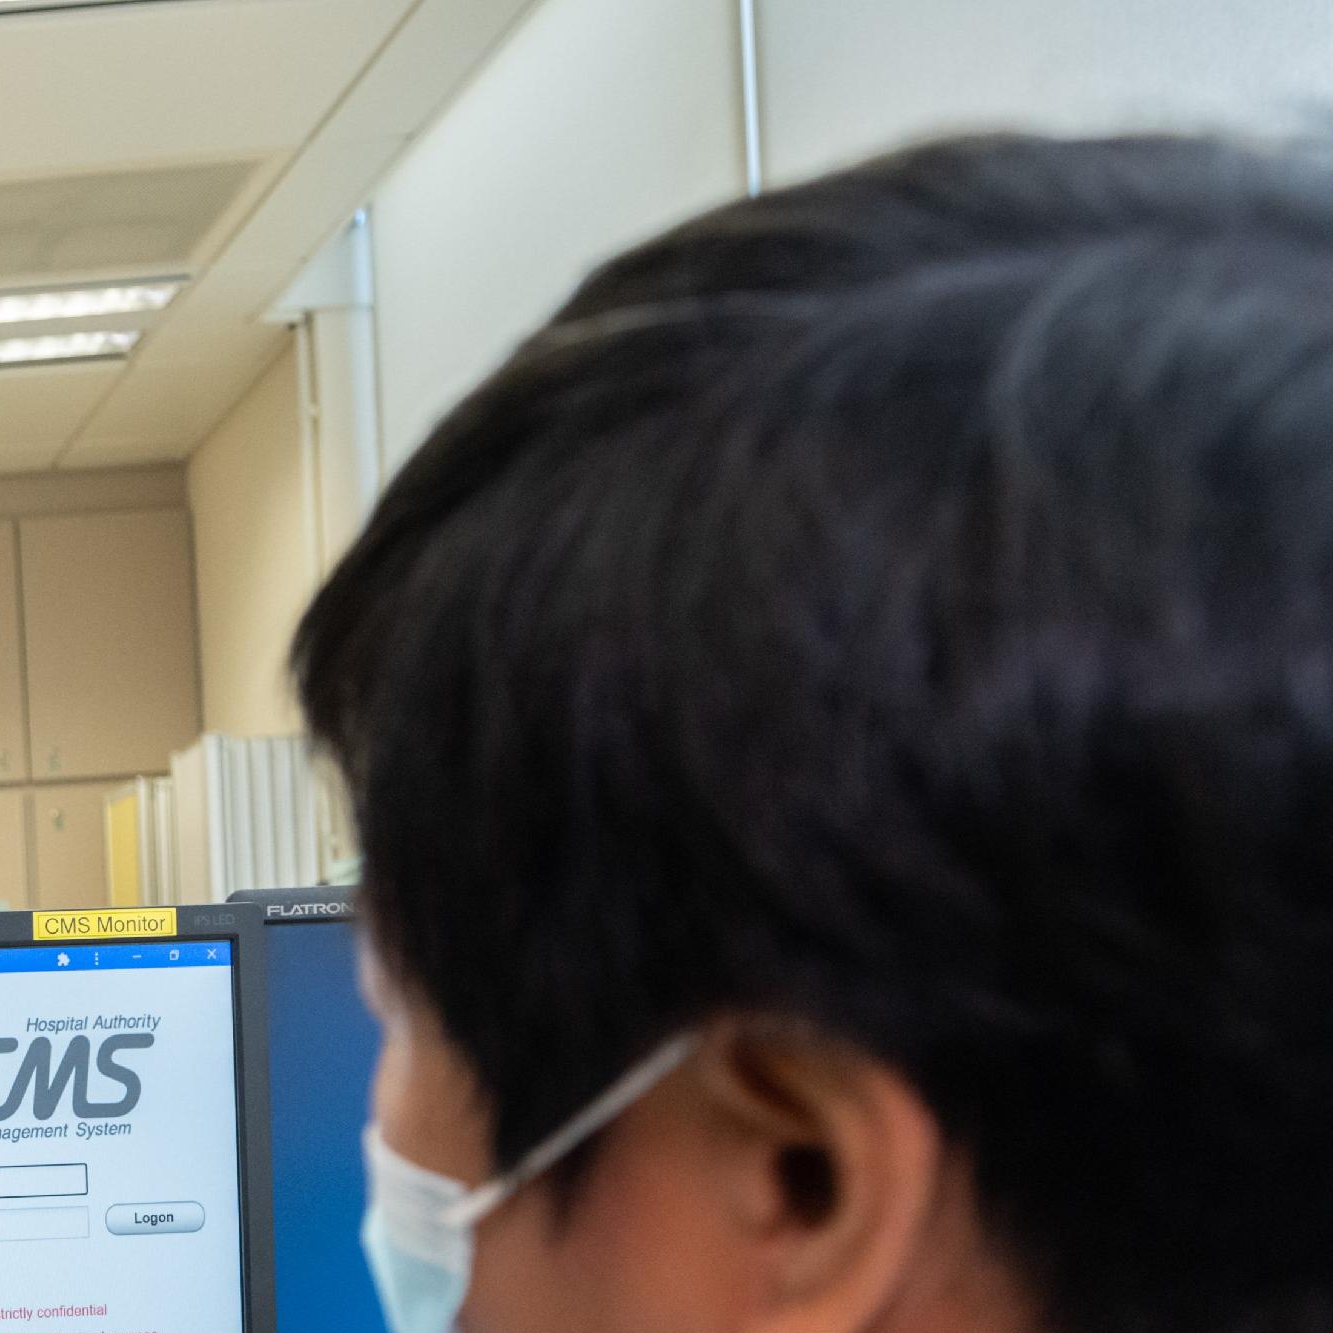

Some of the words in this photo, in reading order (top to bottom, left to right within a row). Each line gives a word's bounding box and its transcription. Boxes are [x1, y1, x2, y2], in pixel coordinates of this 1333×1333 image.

[44, 916, 90, 935] CMS
[97, 915, 165, 933] Monitor
[26, 1016, 88, 1034] Hospital
[92, 1013, 161, 1032] Authority
[75, 1120, 131, 1139] System
[134, 1210, 174, 1226] Logon
[37, 1304, 107, 1319] confidential
